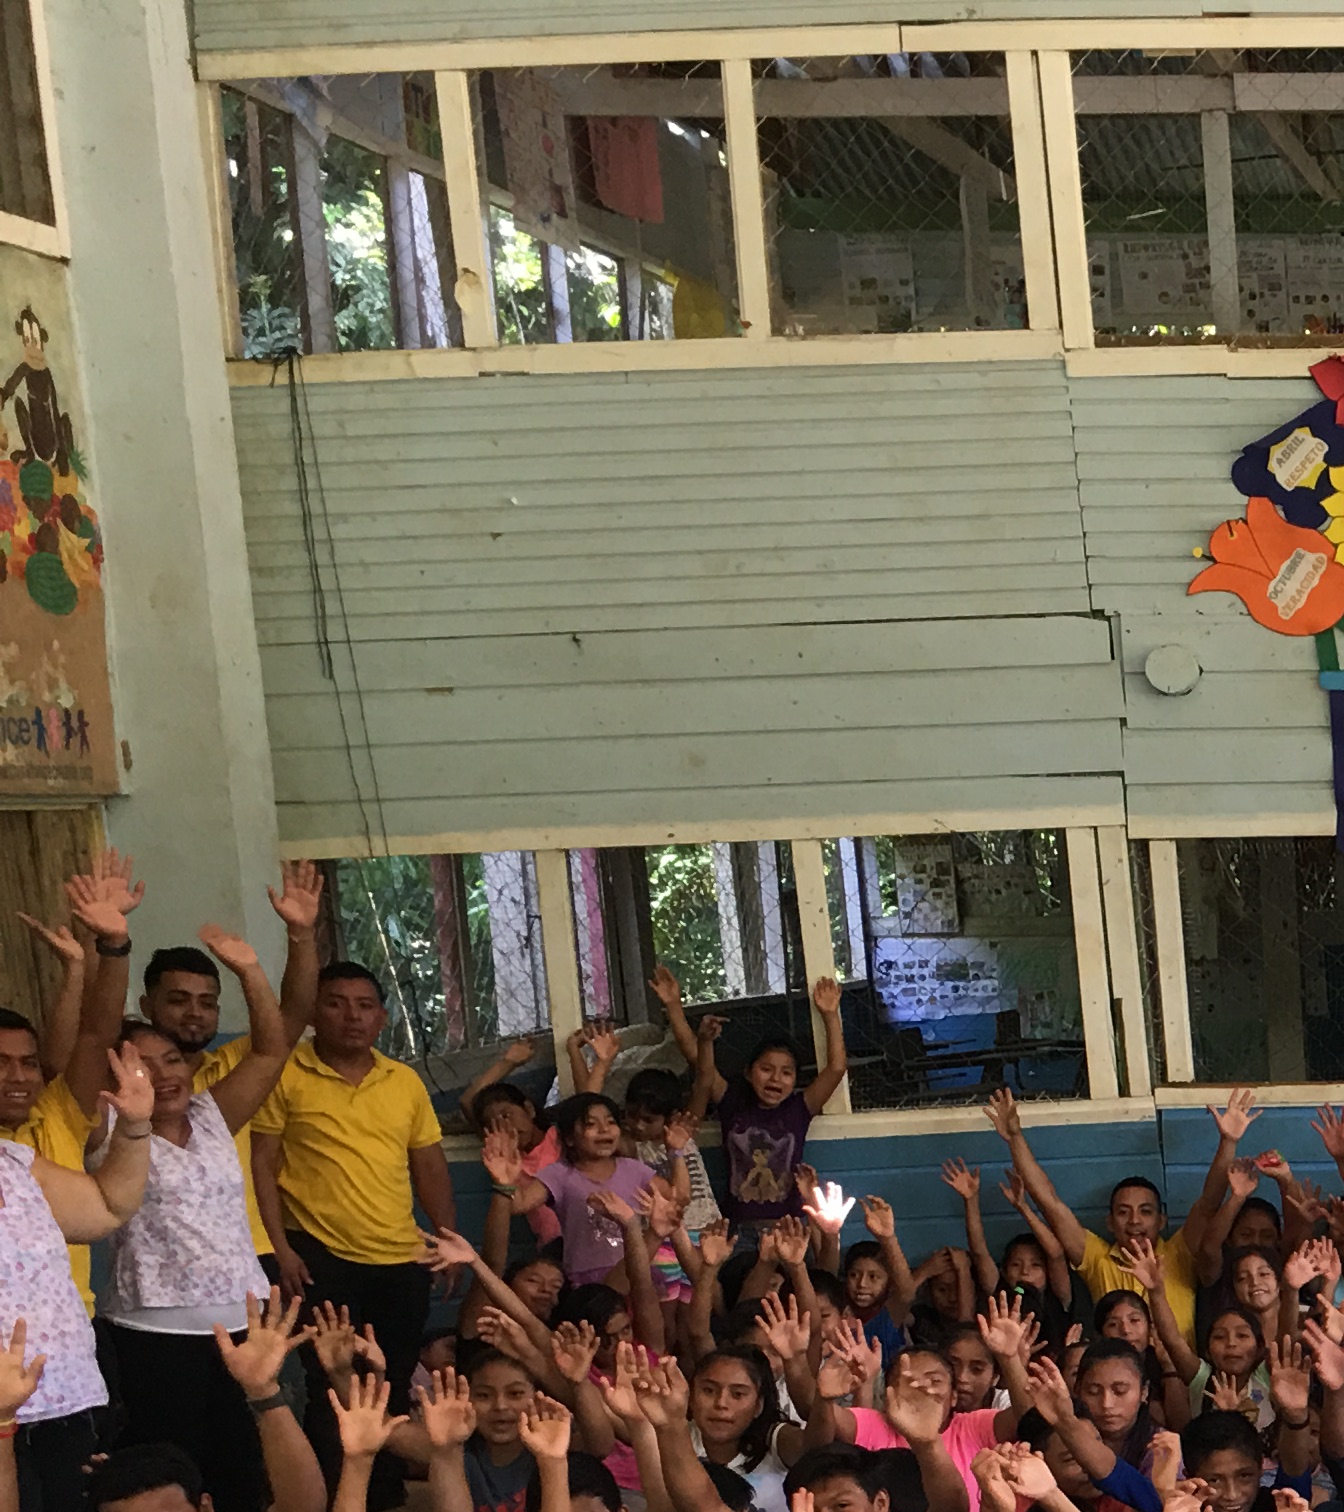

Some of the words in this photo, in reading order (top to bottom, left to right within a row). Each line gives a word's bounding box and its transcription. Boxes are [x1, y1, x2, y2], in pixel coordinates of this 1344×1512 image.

[1275, 435, 1306, 469] ABRIL
[1284, 441, 1325, 490] RESPETO
[1269, 550, 1306, 601] OCTUBRE
[1280, 555, 1326, 619] VERACIDAD
